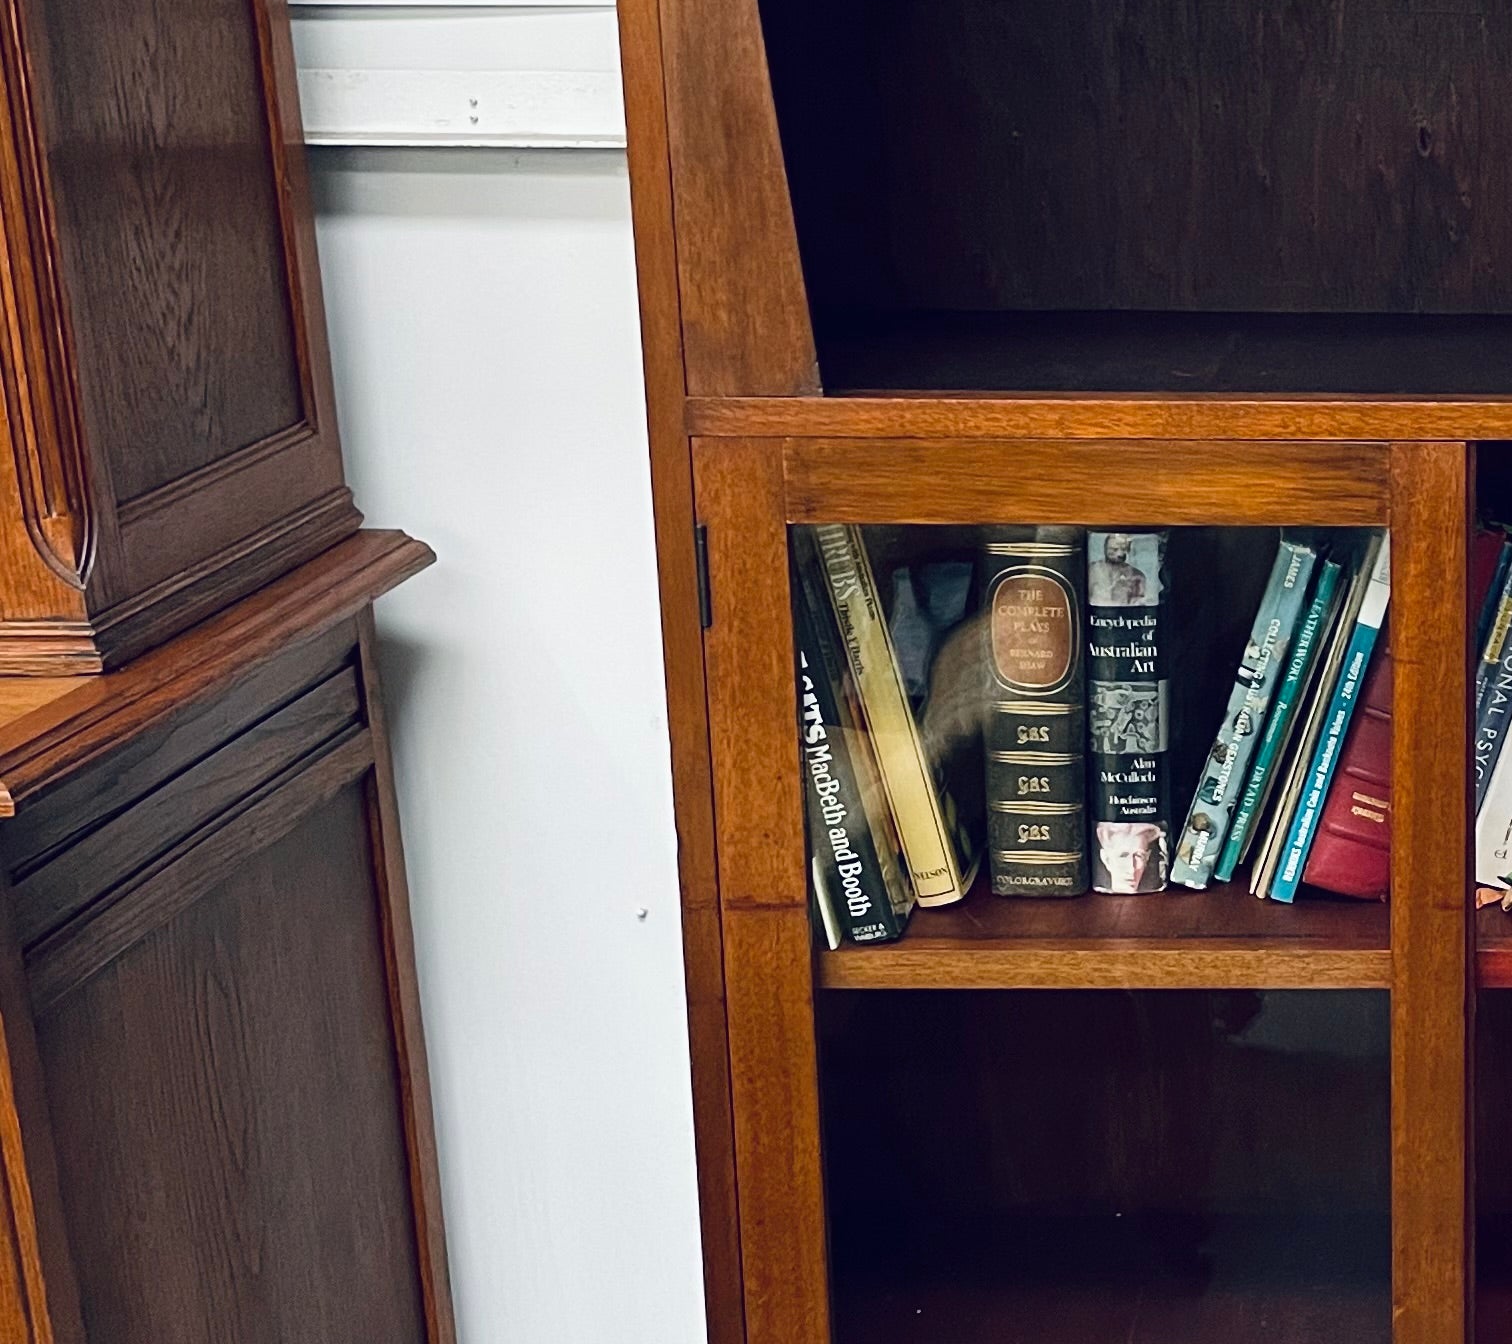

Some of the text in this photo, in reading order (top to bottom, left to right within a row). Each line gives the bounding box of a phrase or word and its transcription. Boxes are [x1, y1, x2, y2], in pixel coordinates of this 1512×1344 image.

[1284, 554, 1302, 590] JAMES
[1018, 589, 1043, 601] THE
[998, 606, 1065, 619] COMPLETE
[1090, 614, 1157, 630] Encyclopedia
[1014, 621, 1050, 633] PLAYS
[1141, 629, 1155, 641] of
[1252, 617, 1281, 681] COLLECTING
[1286, 597, 1326, 683] LEATHERWORK
[1010, 648, 1054, 659] BERNARD
[1089, 642, 1158, 658] Australian
[1018, 661, 1047, 670] SHAW
[1130, 659, 1155, 673] Art
[1347, 651, 1365, 681] Edition
[1232, 680, 1261, 742] AUSTRALIAN
[1329, 709, 1346, 736] Values
[1016, 725, 1050, 745] GBS
[1130, 757, 1156, 770] Alan
[1317, 736, 1339, 774] Banknote
[1475, 726, 1498, 788] PSYC
[1100, 771, 1156, 784] McCulloch
[1211, 741, 1240, 803] GEMSTONES
[1315, 772, 1326, 790] and
[1017, 775, 1051, 795] GBS
[1109, 795, 1158, 806] Hutchinson
[1230, 765, 1265, 843] DRYAD PRESS
[1306, 789, 1321, 809] Coin
[1120, 805, 1158, 816] Australia
[806, 743, 873, 918] MacBeth and Booth
[1017, 824, 1051, 843] GBS
[1293, 808, 1315, 849] Australian
[1188, 829, 1210, 873] MURRAY
[913, 867, 950, 881] NELSON
